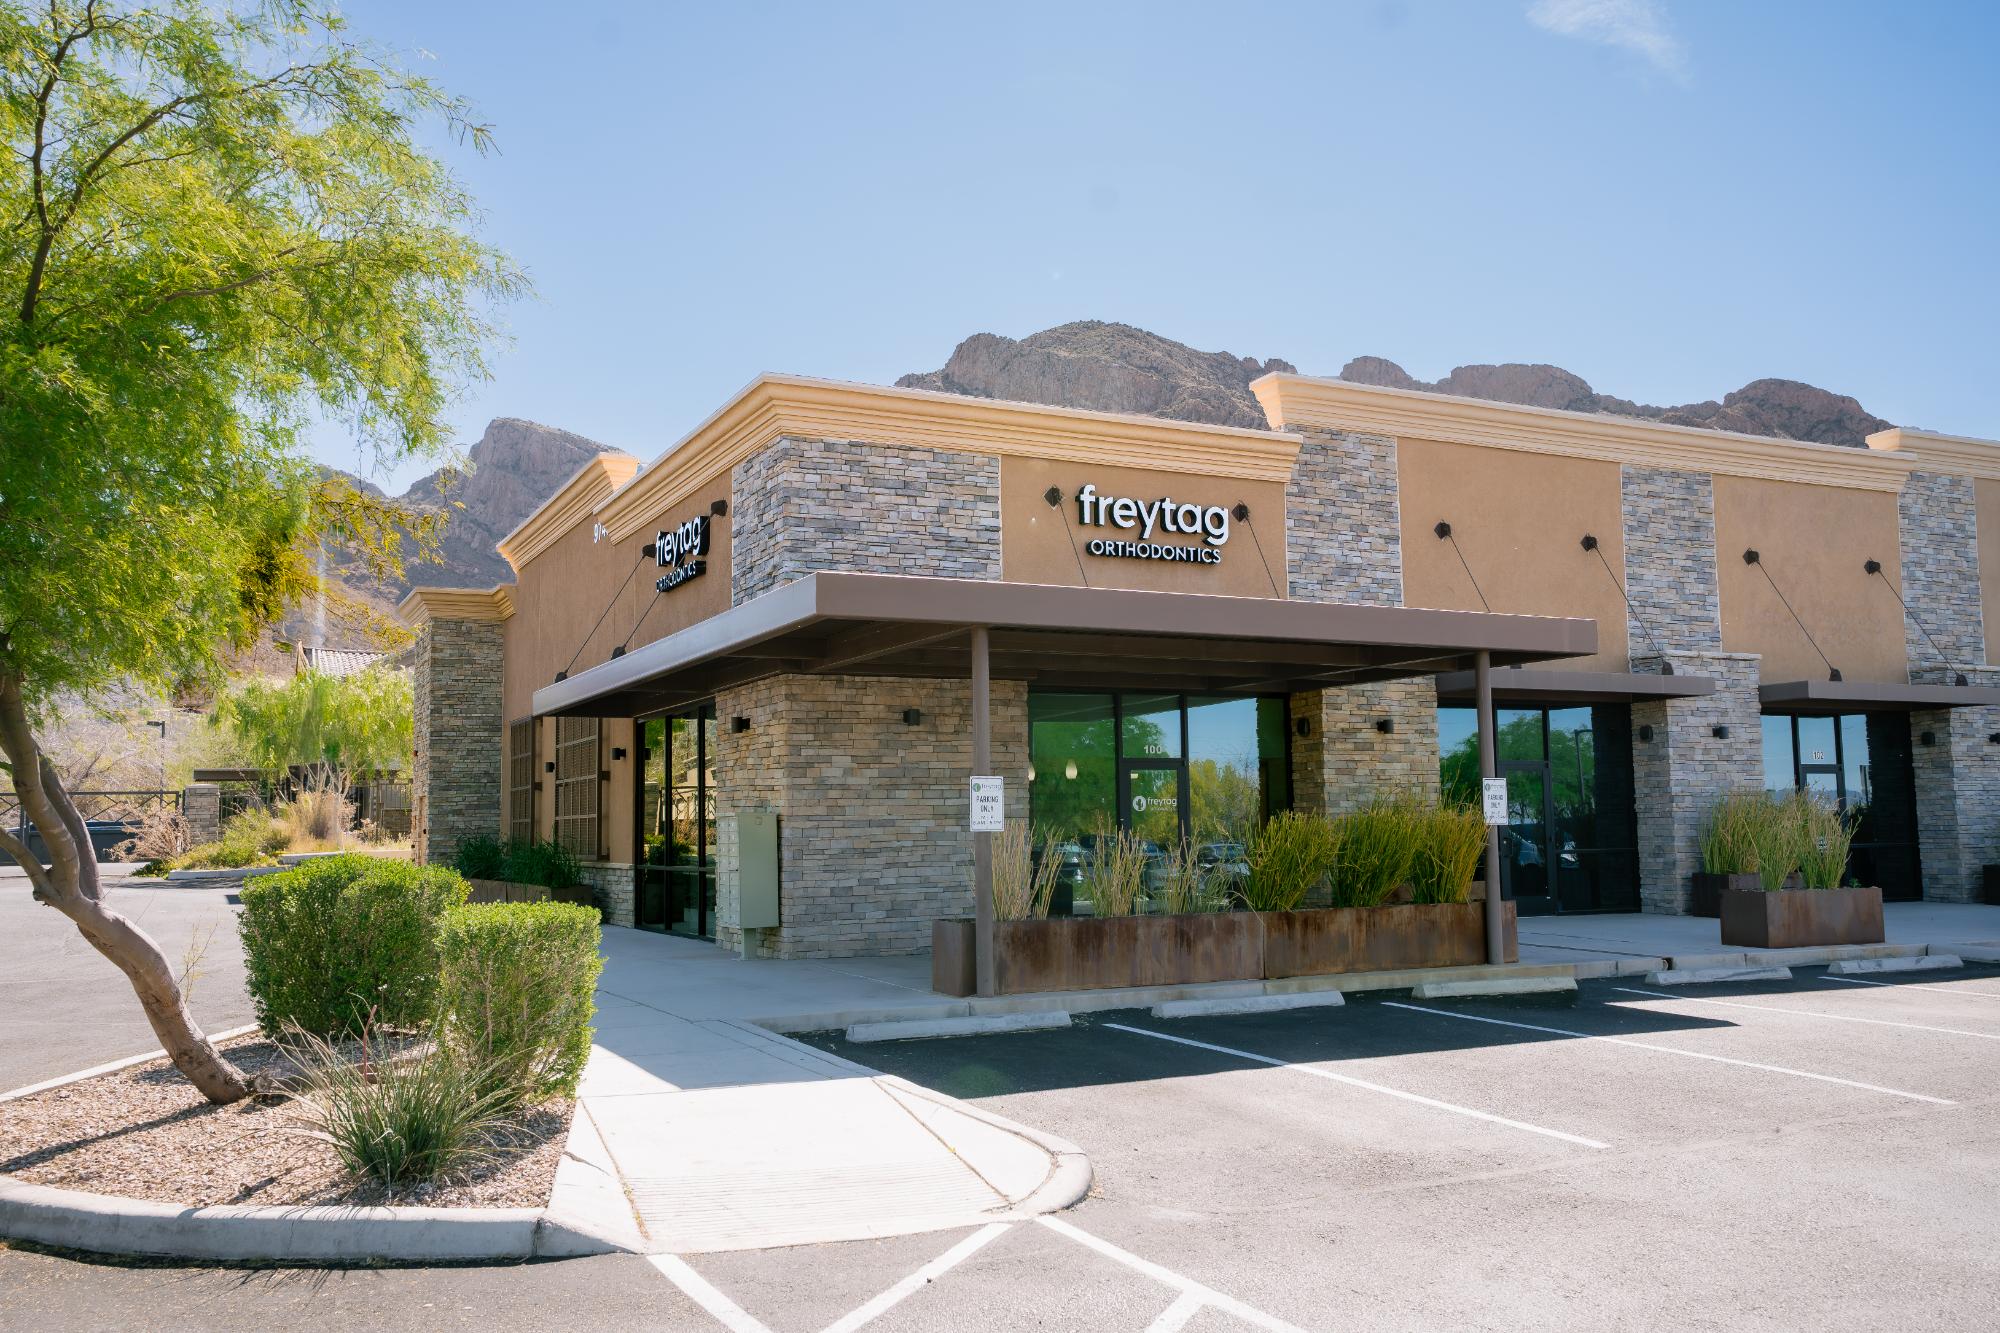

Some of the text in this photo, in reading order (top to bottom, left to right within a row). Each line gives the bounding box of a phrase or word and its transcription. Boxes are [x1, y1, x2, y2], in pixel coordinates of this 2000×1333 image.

[1077, 484, 1230, 546] freytag
[656, 516, 702, 567] freytag
[1089, 539, 1222, 564] ORTHODONTICS
[1143, 745, 1162, 754] 100
[976, 795, 999, 803] PARKING
[1147, 797, 1177, 806] freytag
